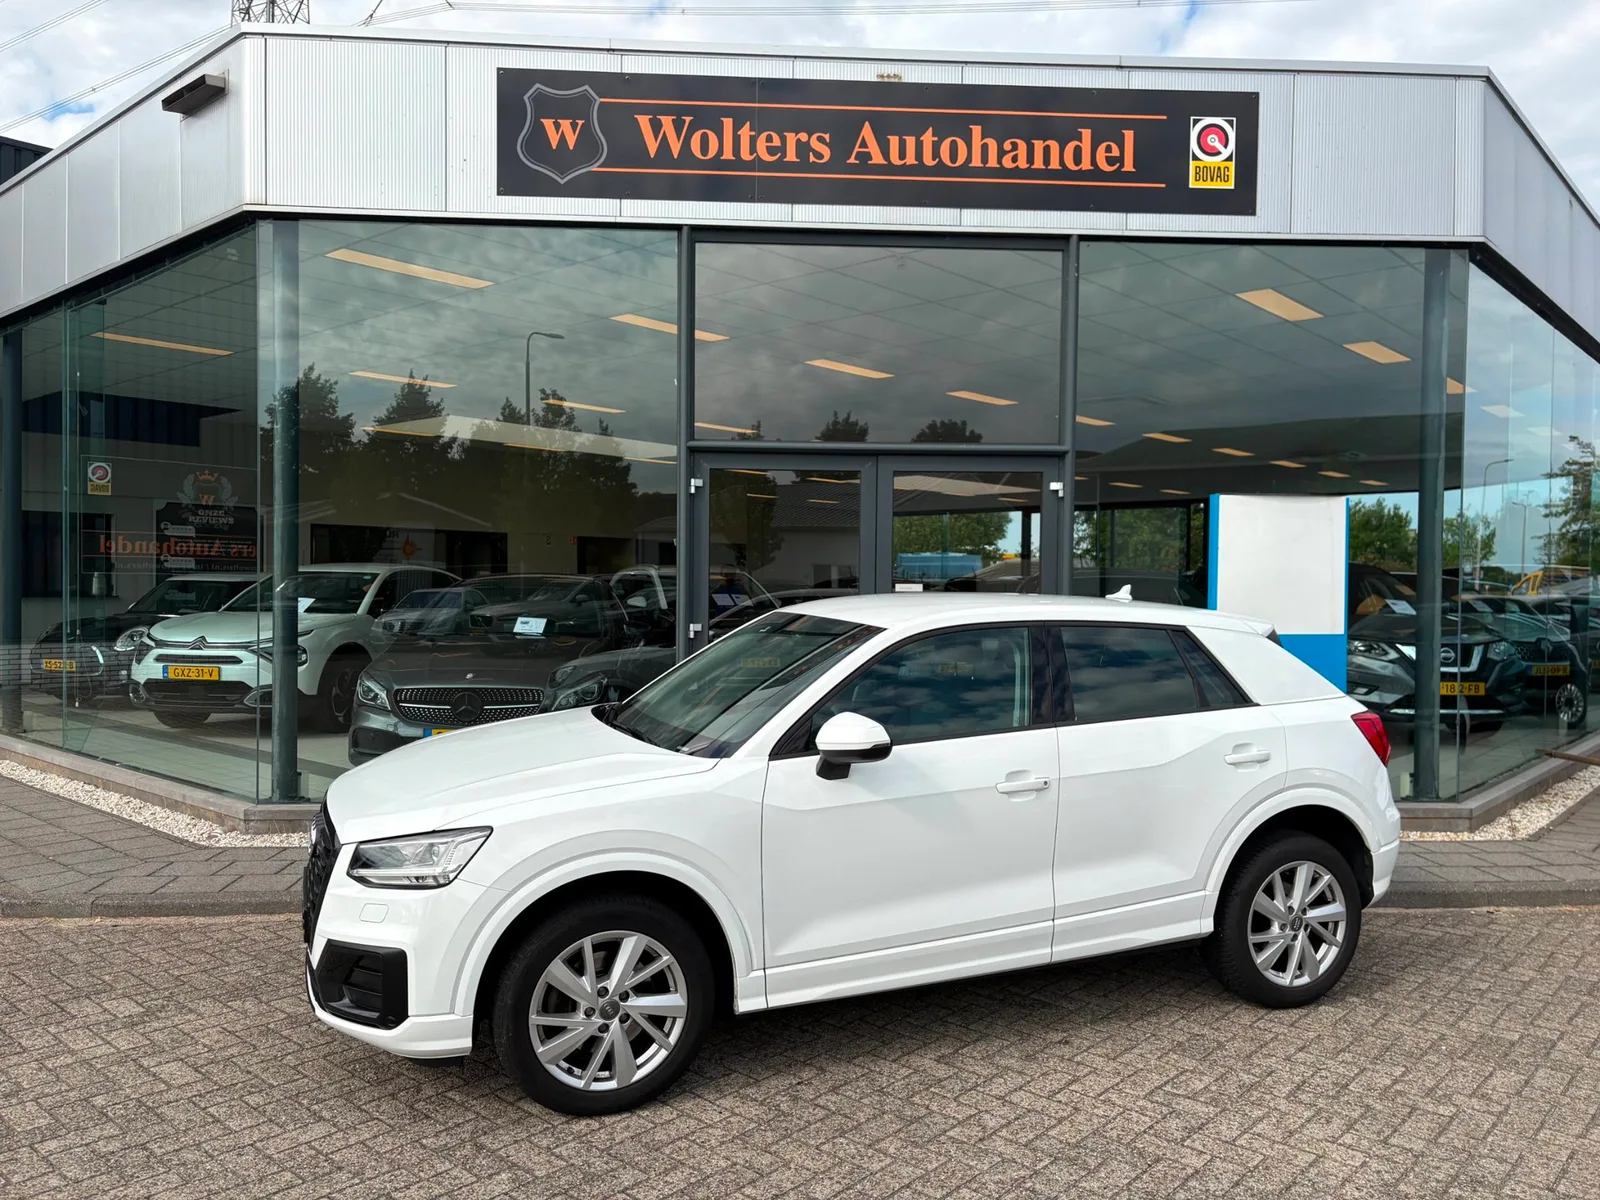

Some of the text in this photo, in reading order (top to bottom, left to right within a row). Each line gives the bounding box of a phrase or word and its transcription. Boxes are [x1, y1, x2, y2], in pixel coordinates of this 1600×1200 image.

[541, 117, 585, 150] W
[634, 113, 1137, 174] Wolters Autohandel
[1194, 165, 1230, 183] BOVAG
[188, 516, 235, 525] REVIEWS
[173, 667, 214, 678] GXZ-31-V
